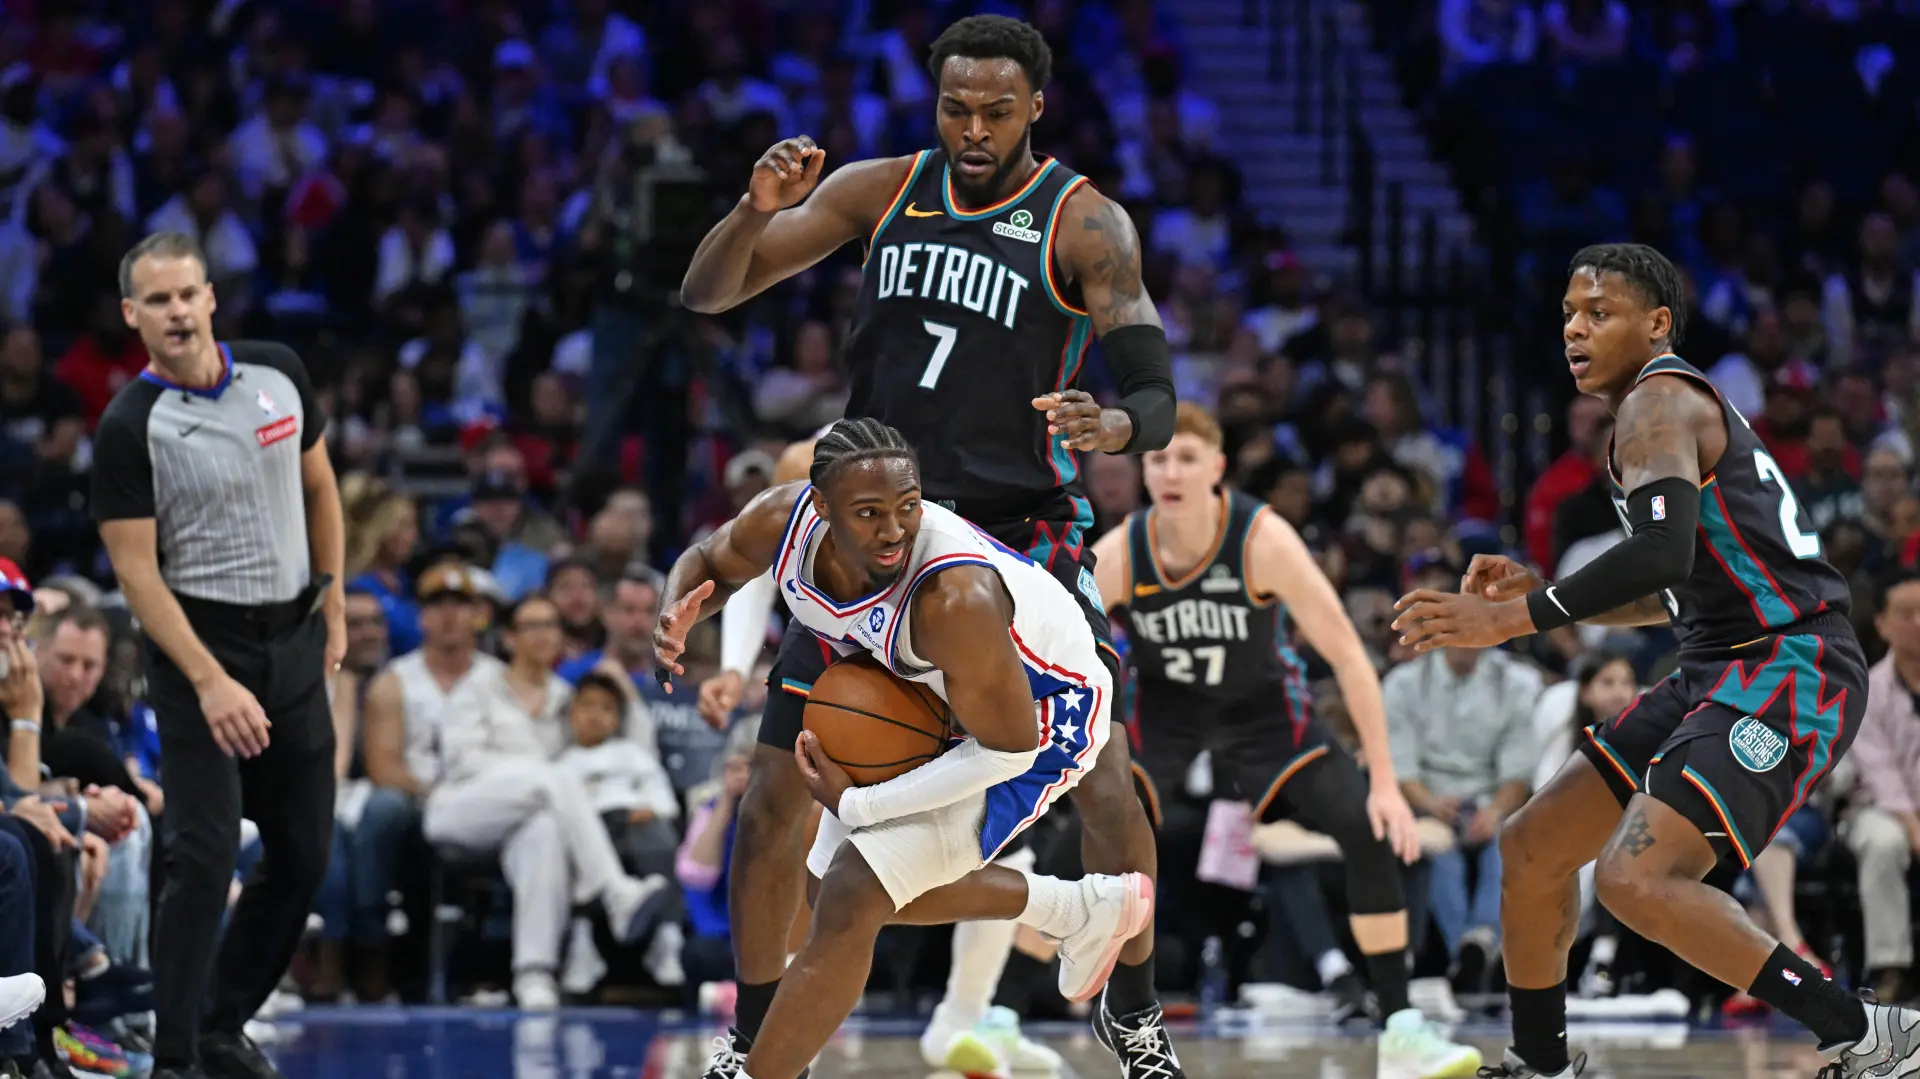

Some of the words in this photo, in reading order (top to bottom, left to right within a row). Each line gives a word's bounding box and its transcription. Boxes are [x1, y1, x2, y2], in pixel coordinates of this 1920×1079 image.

[994, 224, 1039, 240] StockX
[878, 242, 1030, 330] DETROIT
[918, 319, 958, 390] 7
[1753, 449, 1820, 559] 2
[1161, 645, 1226, 686] 27
[1736, 727, 1774, 763] PISTONS
[1747, 718, 1784, 753] DETROIT
